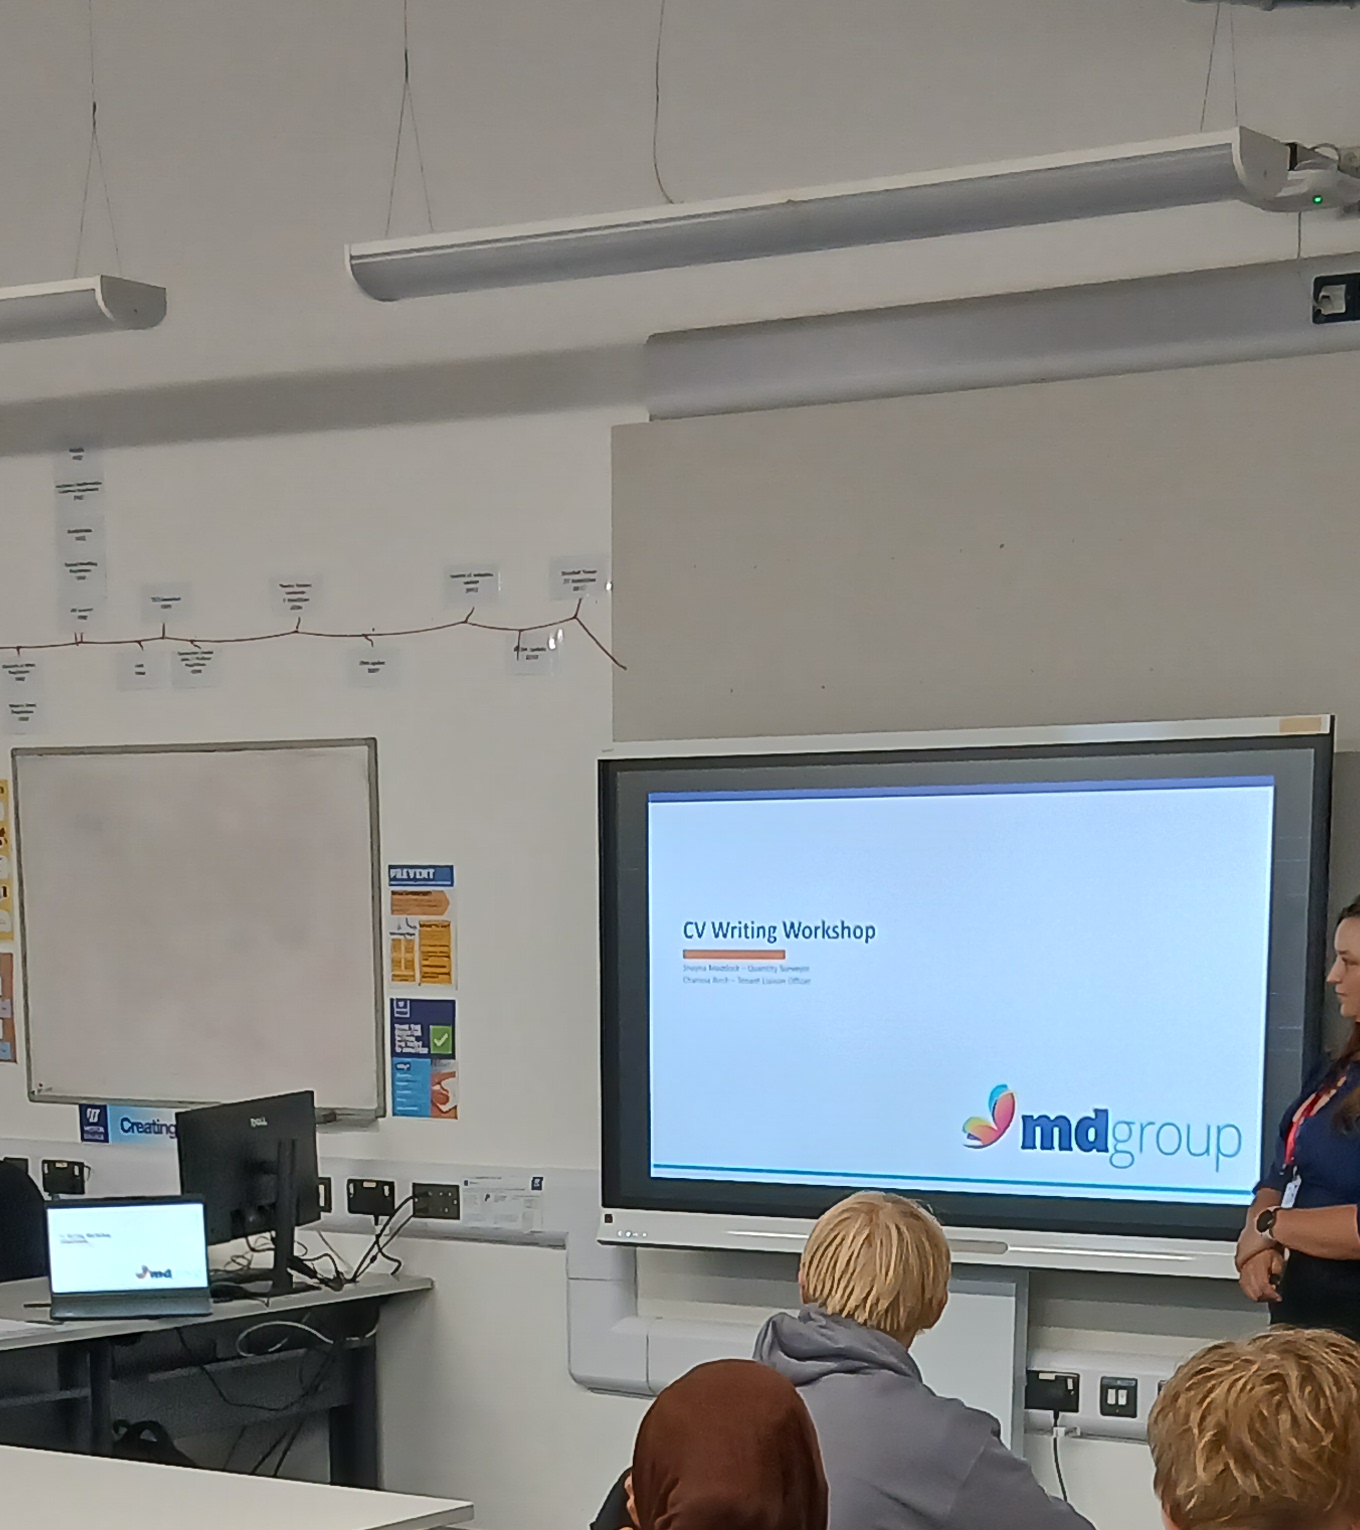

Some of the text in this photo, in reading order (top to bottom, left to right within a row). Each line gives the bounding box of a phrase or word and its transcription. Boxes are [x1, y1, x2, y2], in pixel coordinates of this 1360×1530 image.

[683, 918, 876, 944] CV Writing Workshop
[120, 1117, 177, 1139] Creating
[1021, 1108, 1242, 1173] mdgroup
